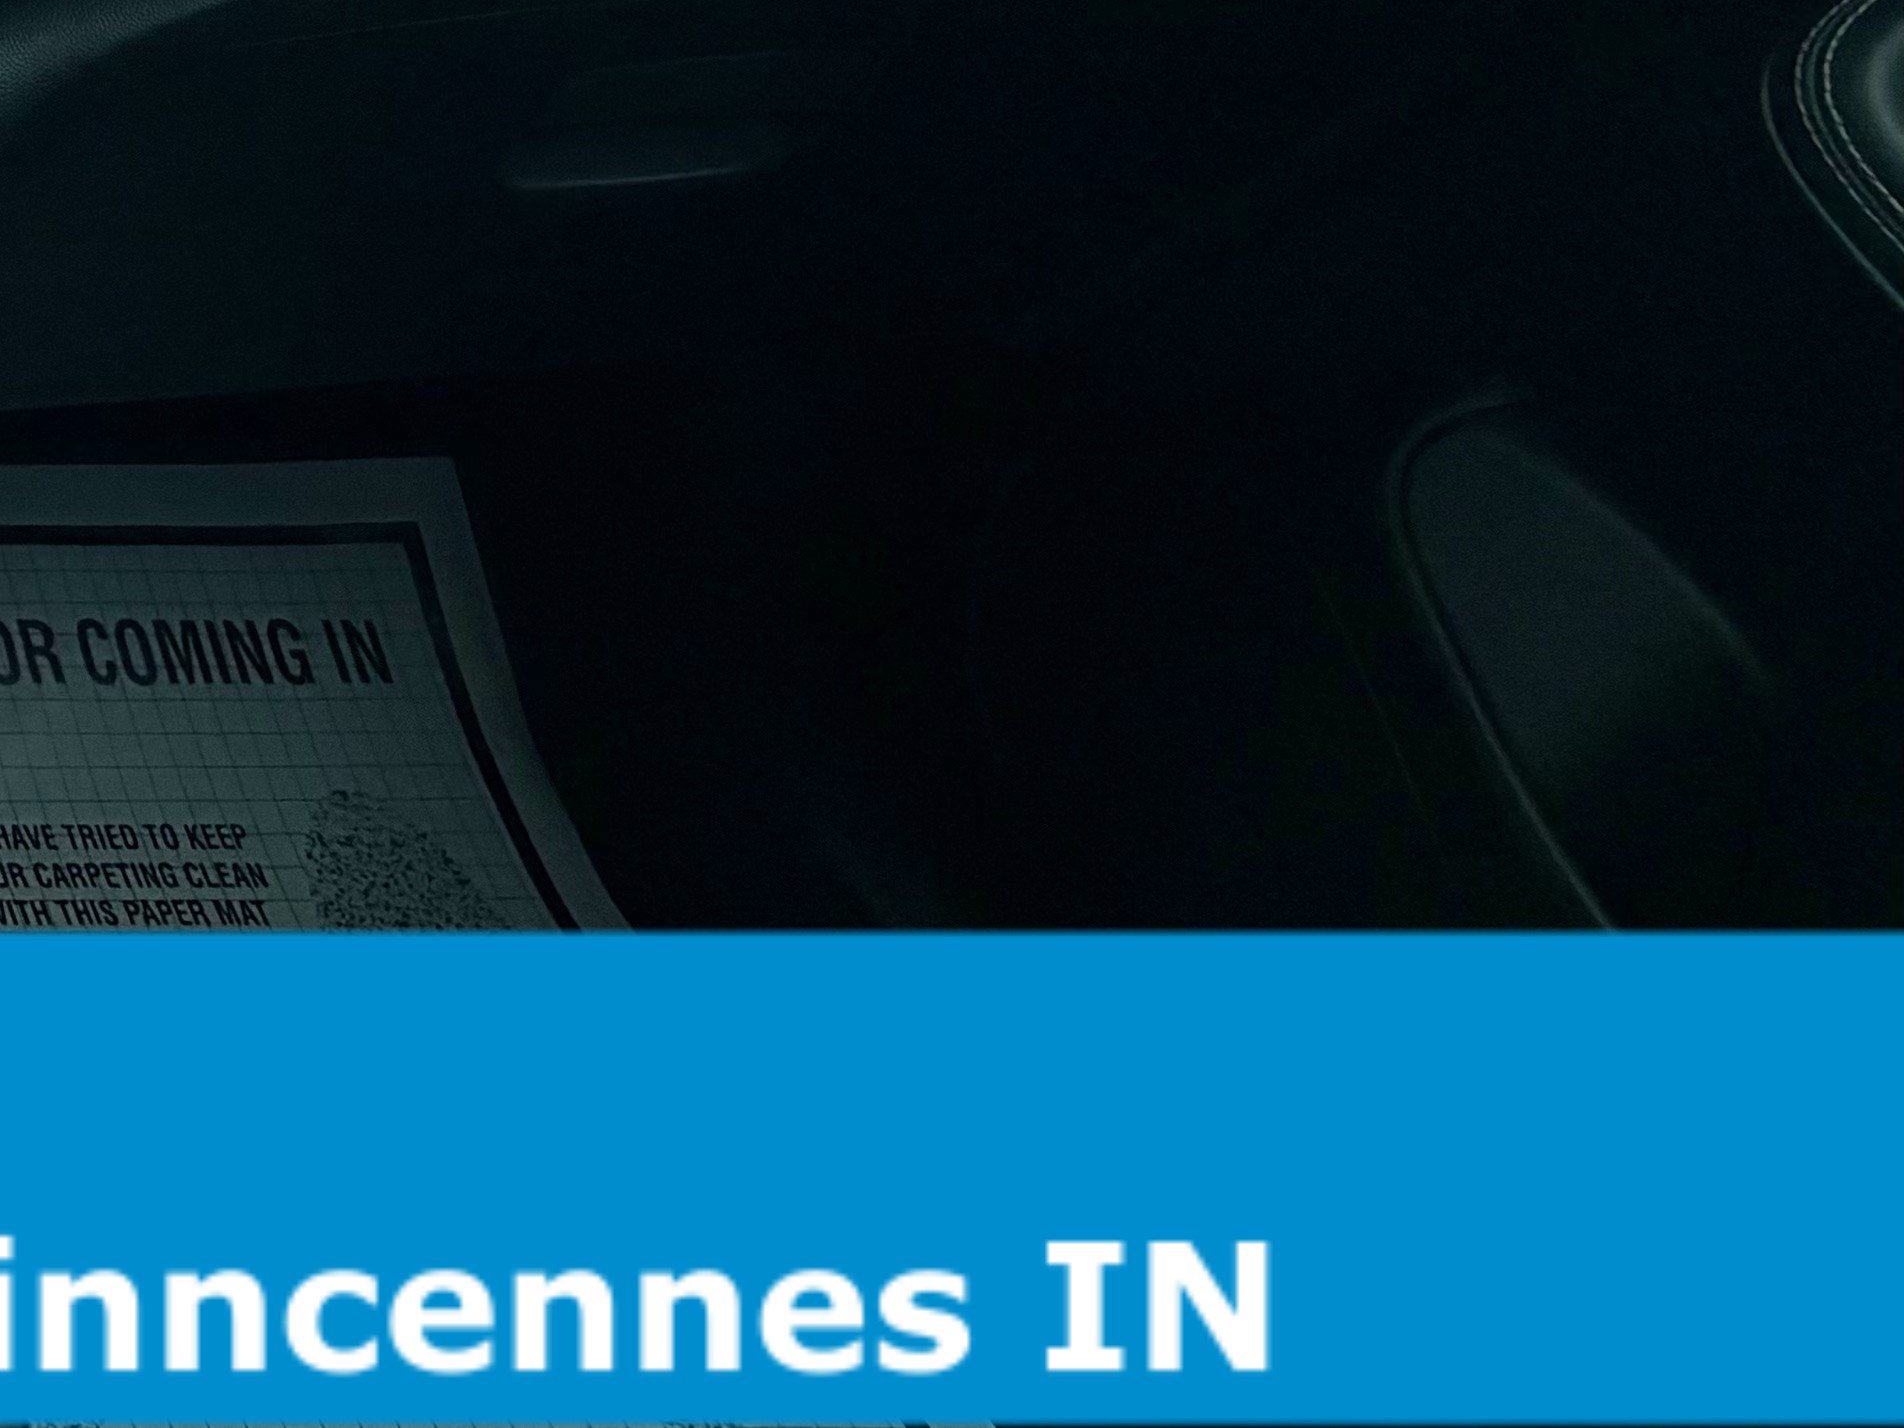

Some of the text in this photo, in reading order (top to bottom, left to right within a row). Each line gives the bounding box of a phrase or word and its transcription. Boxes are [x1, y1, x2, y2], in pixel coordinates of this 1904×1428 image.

[76, 617, 312, 687] COMING
[321, 618, 393, 685] IN
[60, 824, 139, 850] TRIED
[141, 824, 180, 850] TO
[183, 824, 246, 850] KEEP
[32, 862, 178, 889] CARPETING
[182, 862, 269, 889] CLEAN
[54, 899, 119, 926] THIS
[122, 899, 211, 926] PAPER
[211, 899, 271, 926] MAT
